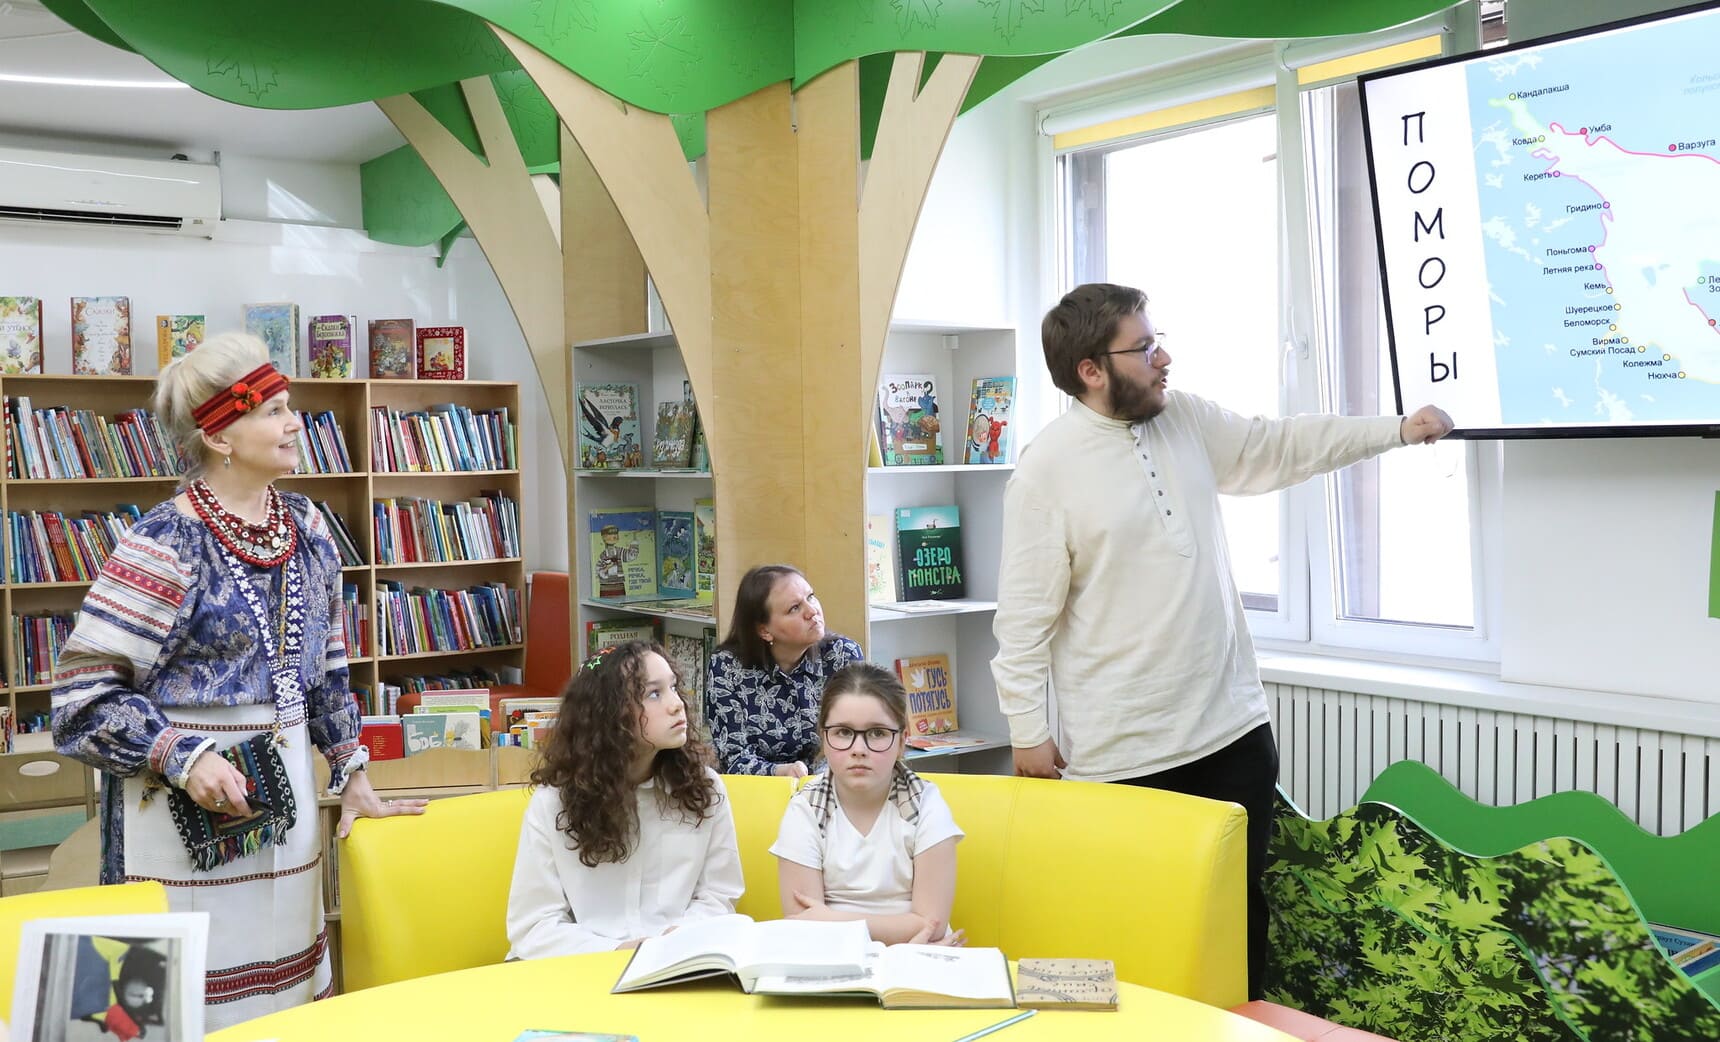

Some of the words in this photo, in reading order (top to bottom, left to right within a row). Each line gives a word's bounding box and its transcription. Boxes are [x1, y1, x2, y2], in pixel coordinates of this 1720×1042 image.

[1517, 83, 1570, 99] Кандалакша
[1588, 123, 1612, 135] Умба
[1512, 136, 1538, 147] Ковда
[1679, 139, 1716, 151] Варзуга
[1523, 172, 1553, 183] Кереть
[1566, 202, 1603, 215] Гридино
[1547, 245, 1587, 256] Поньгома
[1543, 266, 1573, 275] Летняя
[1574, 263, 1595, 274] река
[1584, 282, 1607, 290] Кемь
[1566, 304, 1613, 314] Шуерецкое
[1564, 318, 1611, 328] Беломорск
[1592, 336, 1621, 347] Вирма
[1569, 346, 1606, 359] Сумский
[1608, 345, 1636, 355] Посад
[1623, 359, 1662, 368] Колежма
[1647, 370, 1678, 381] Нюхча
[916, 546, 952, 568] ОЗЕРО
[908, 566, 962, 588] МОНСТРА
[609, 631, 639, 640] РОДНАЯ
[909, 689, 952, 715] ПОТЯГУСЬ
